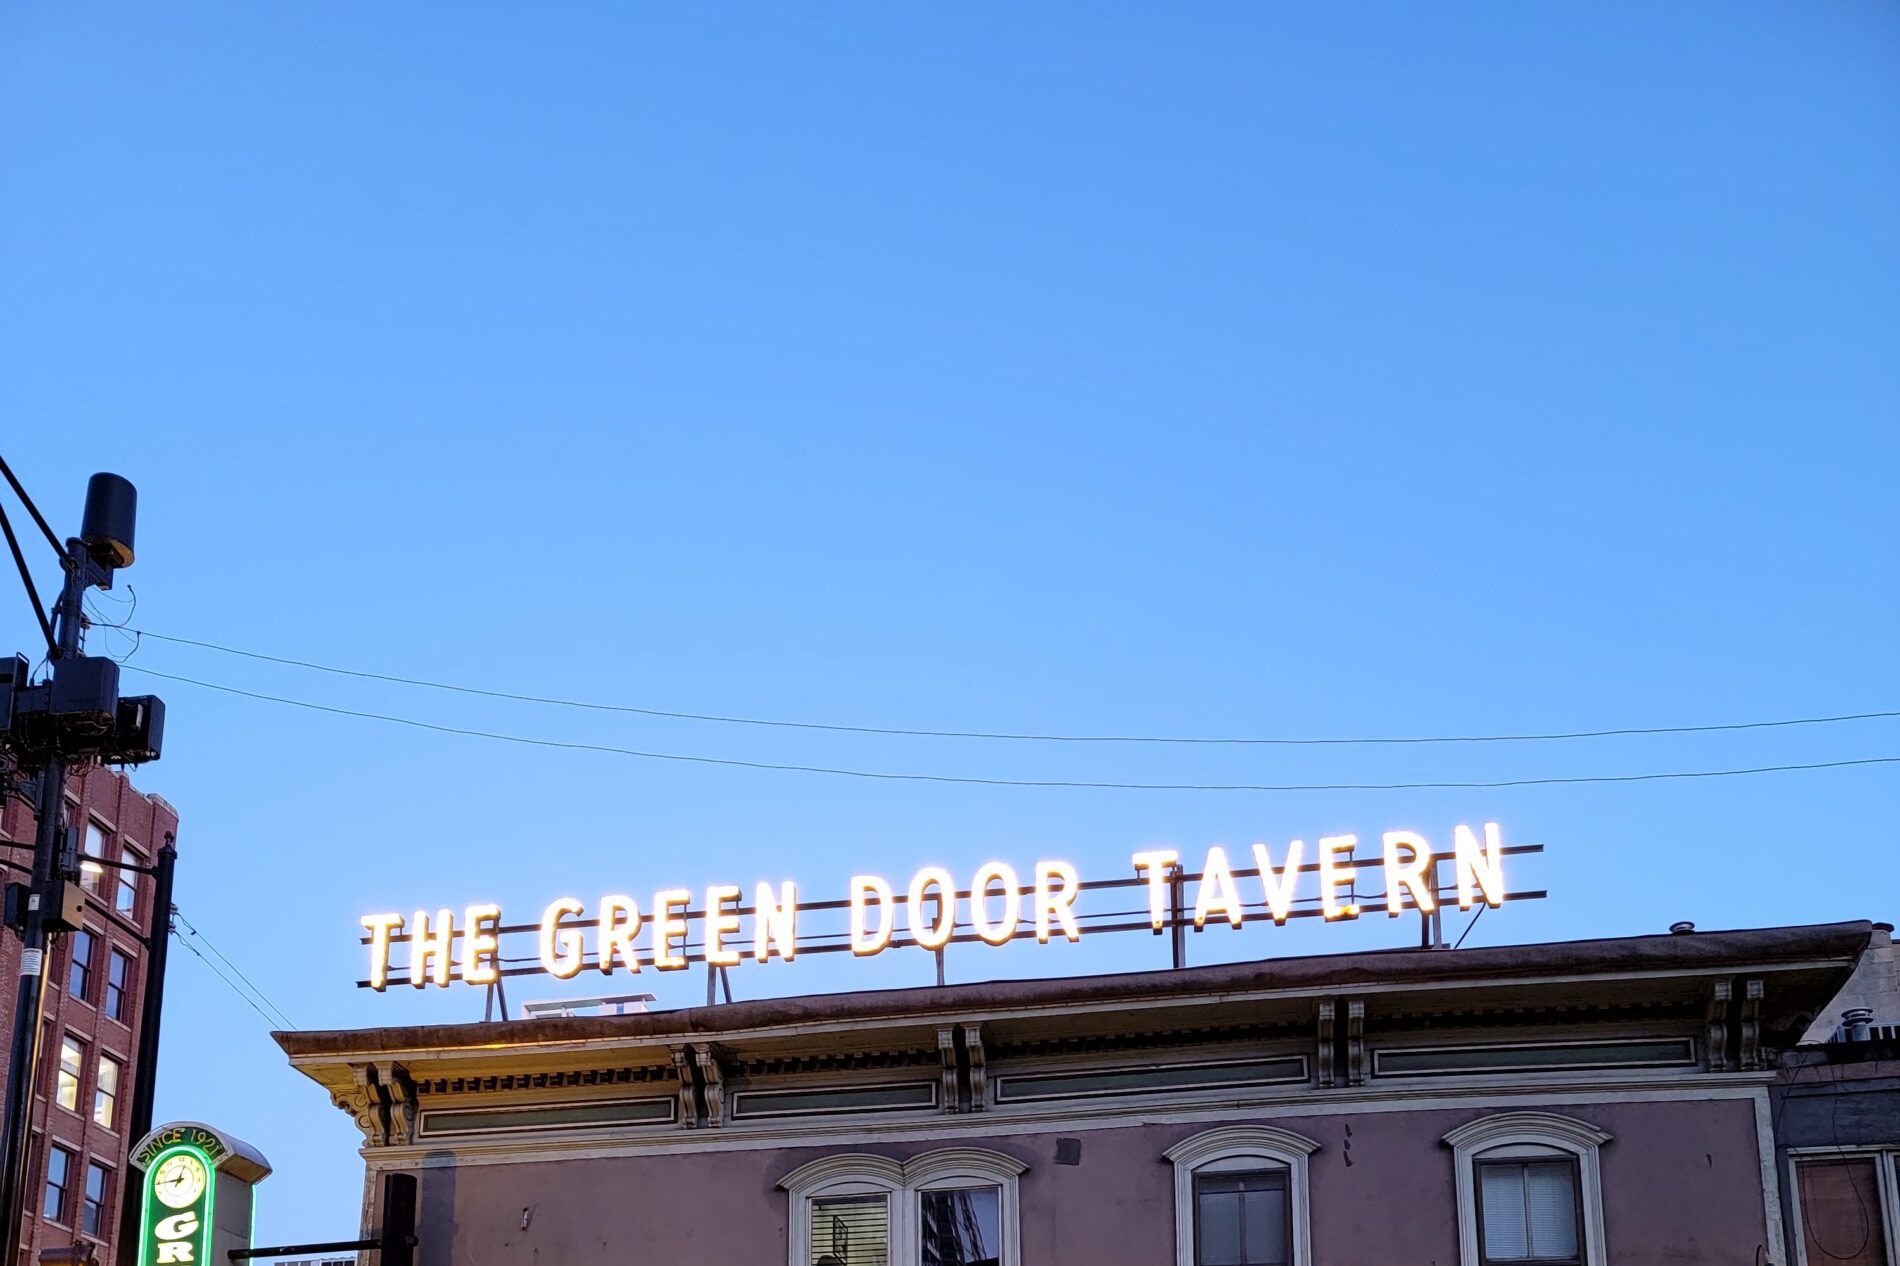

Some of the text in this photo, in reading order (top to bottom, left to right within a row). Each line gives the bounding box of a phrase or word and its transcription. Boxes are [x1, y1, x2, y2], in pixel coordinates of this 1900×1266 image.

[361, 821, 1503, 992] THE GREEN DOOR TAVERN
[141, 1128, 225, 1162] SINCE 1921
